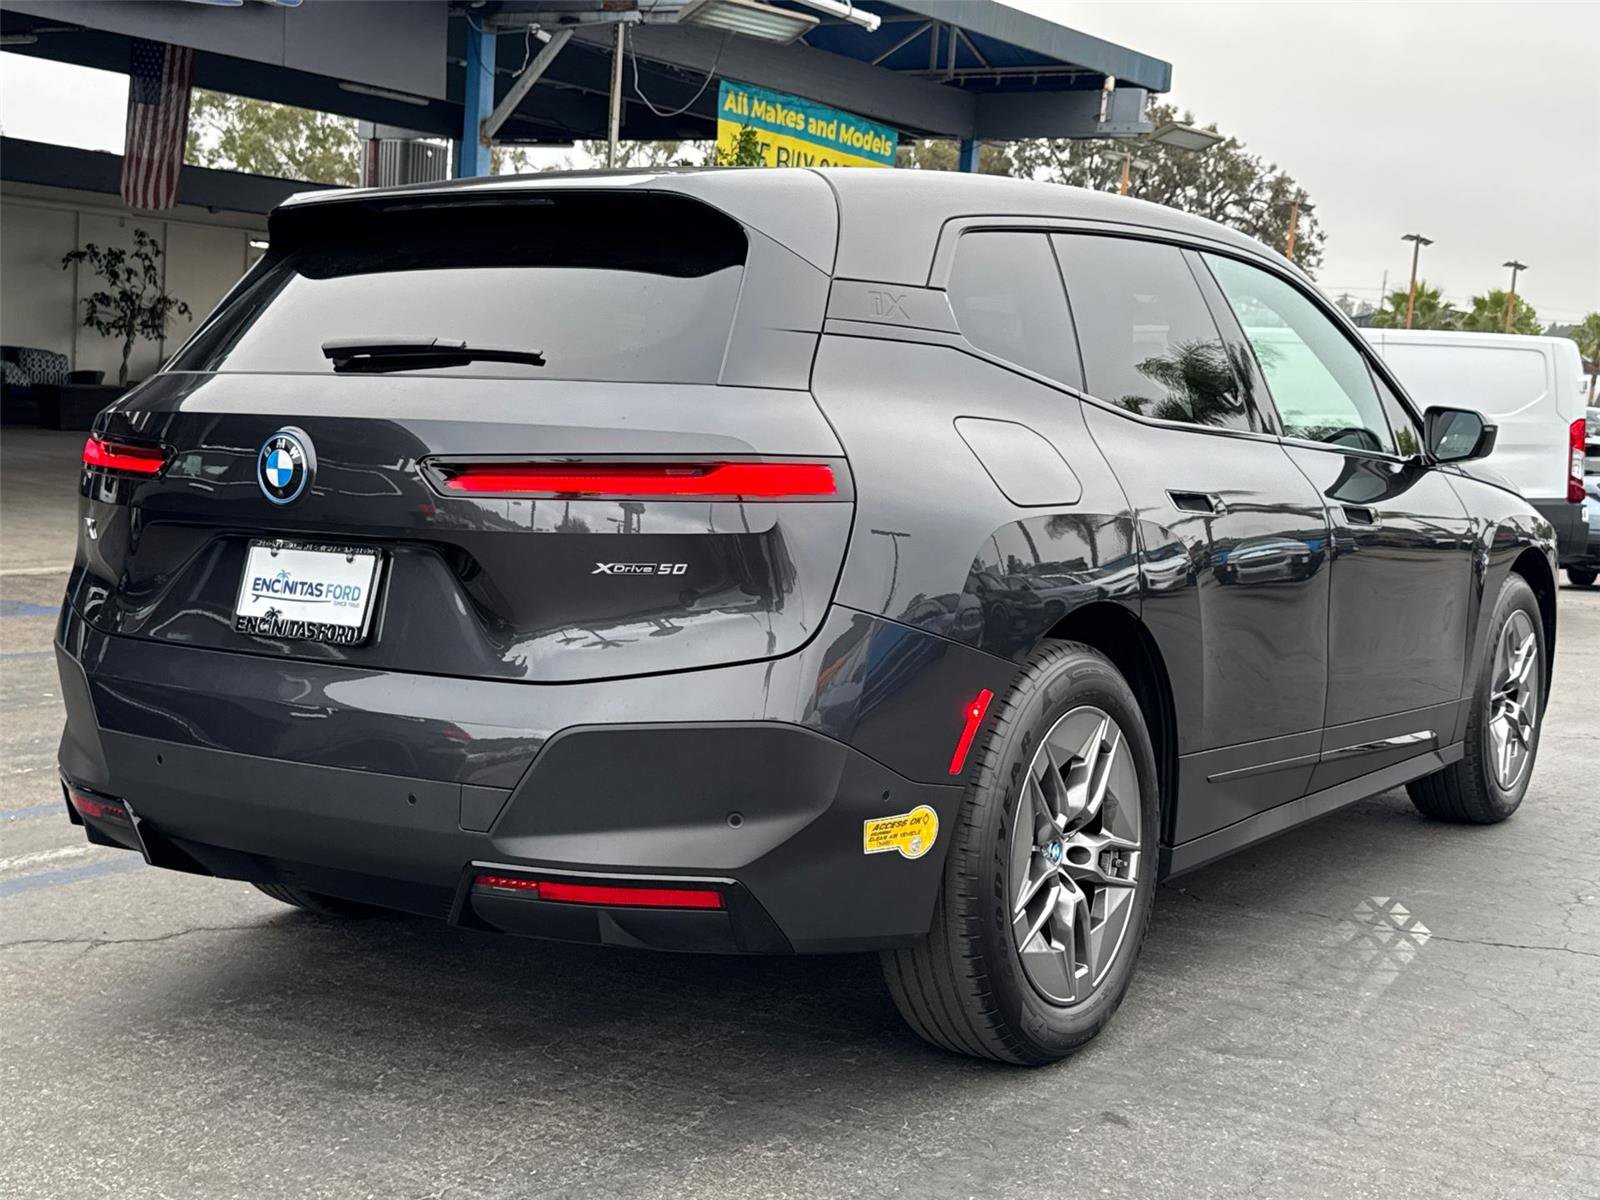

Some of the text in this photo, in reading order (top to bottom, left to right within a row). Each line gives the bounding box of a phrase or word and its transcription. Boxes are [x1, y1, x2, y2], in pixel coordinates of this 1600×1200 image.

[723, 91, 892, 156] All Makes and Models
[263, 438, 301, 460] BMW
[657, 563, 688, 575] 50
[252, 571, 361, 602] ENCINITAS FORD
[235, 609, 359, 644] ENCINITAS FORD
[872, 816, 922, 831] ACCESS OK
